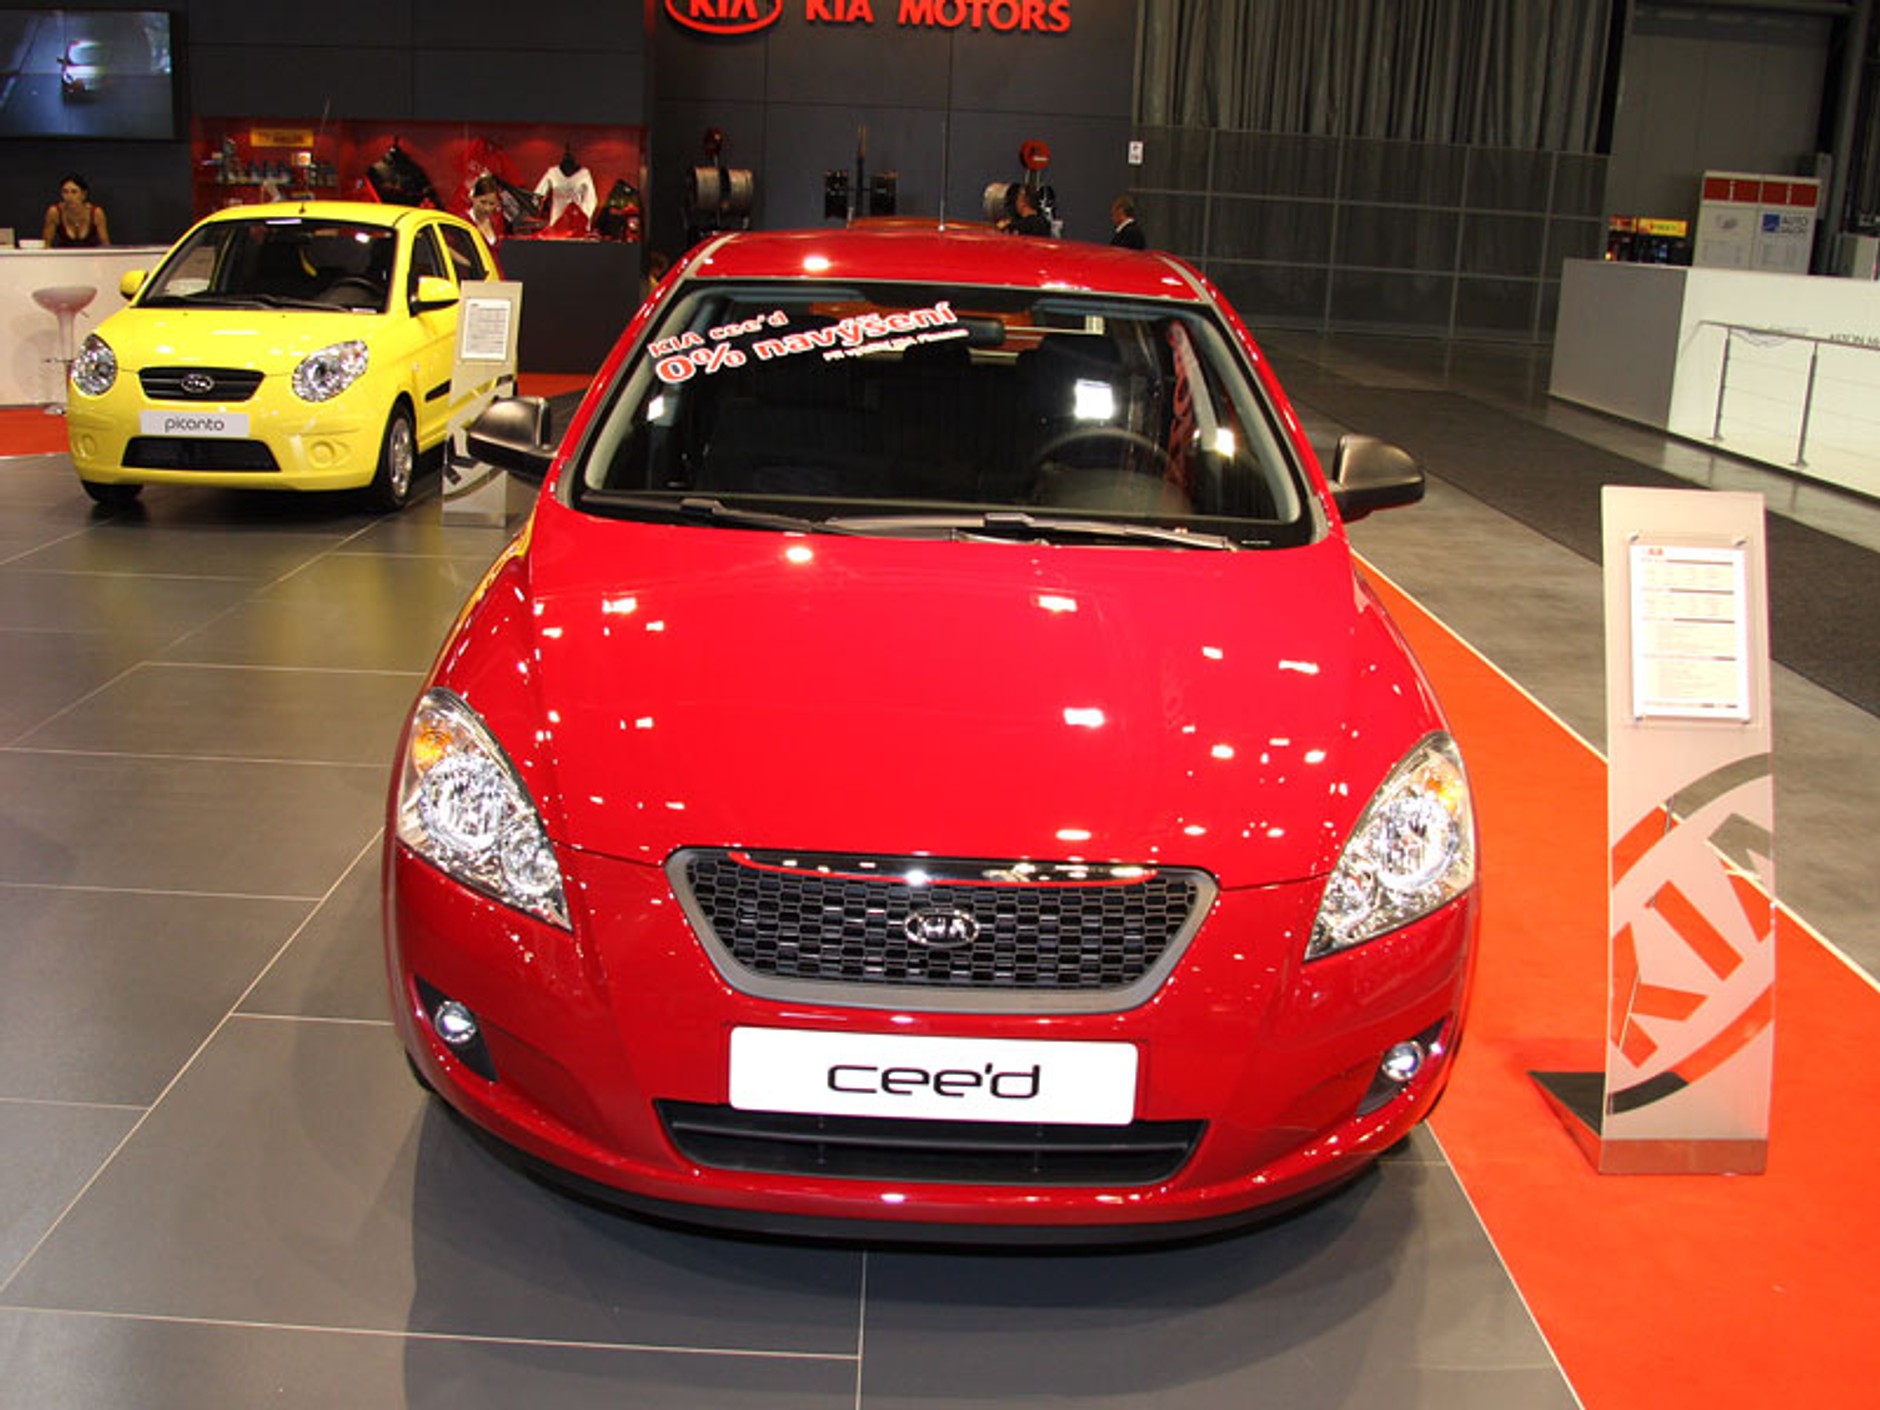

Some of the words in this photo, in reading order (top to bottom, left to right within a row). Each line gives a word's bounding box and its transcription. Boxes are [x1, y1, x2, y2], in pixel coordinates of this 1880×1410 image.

[689, 0, 758, 19] KIA
[805, 0, 874, 23] KIA
[898, 0, 1071, 33] MOTORS
[647, 330, 705, 358] KIA
[655, 341, 747, 383] 0%
[752, 300, 959, 361] navýšení
[164, 417, 225, 433] picanto
[827, 1062, 1041, 1099] cee'd
